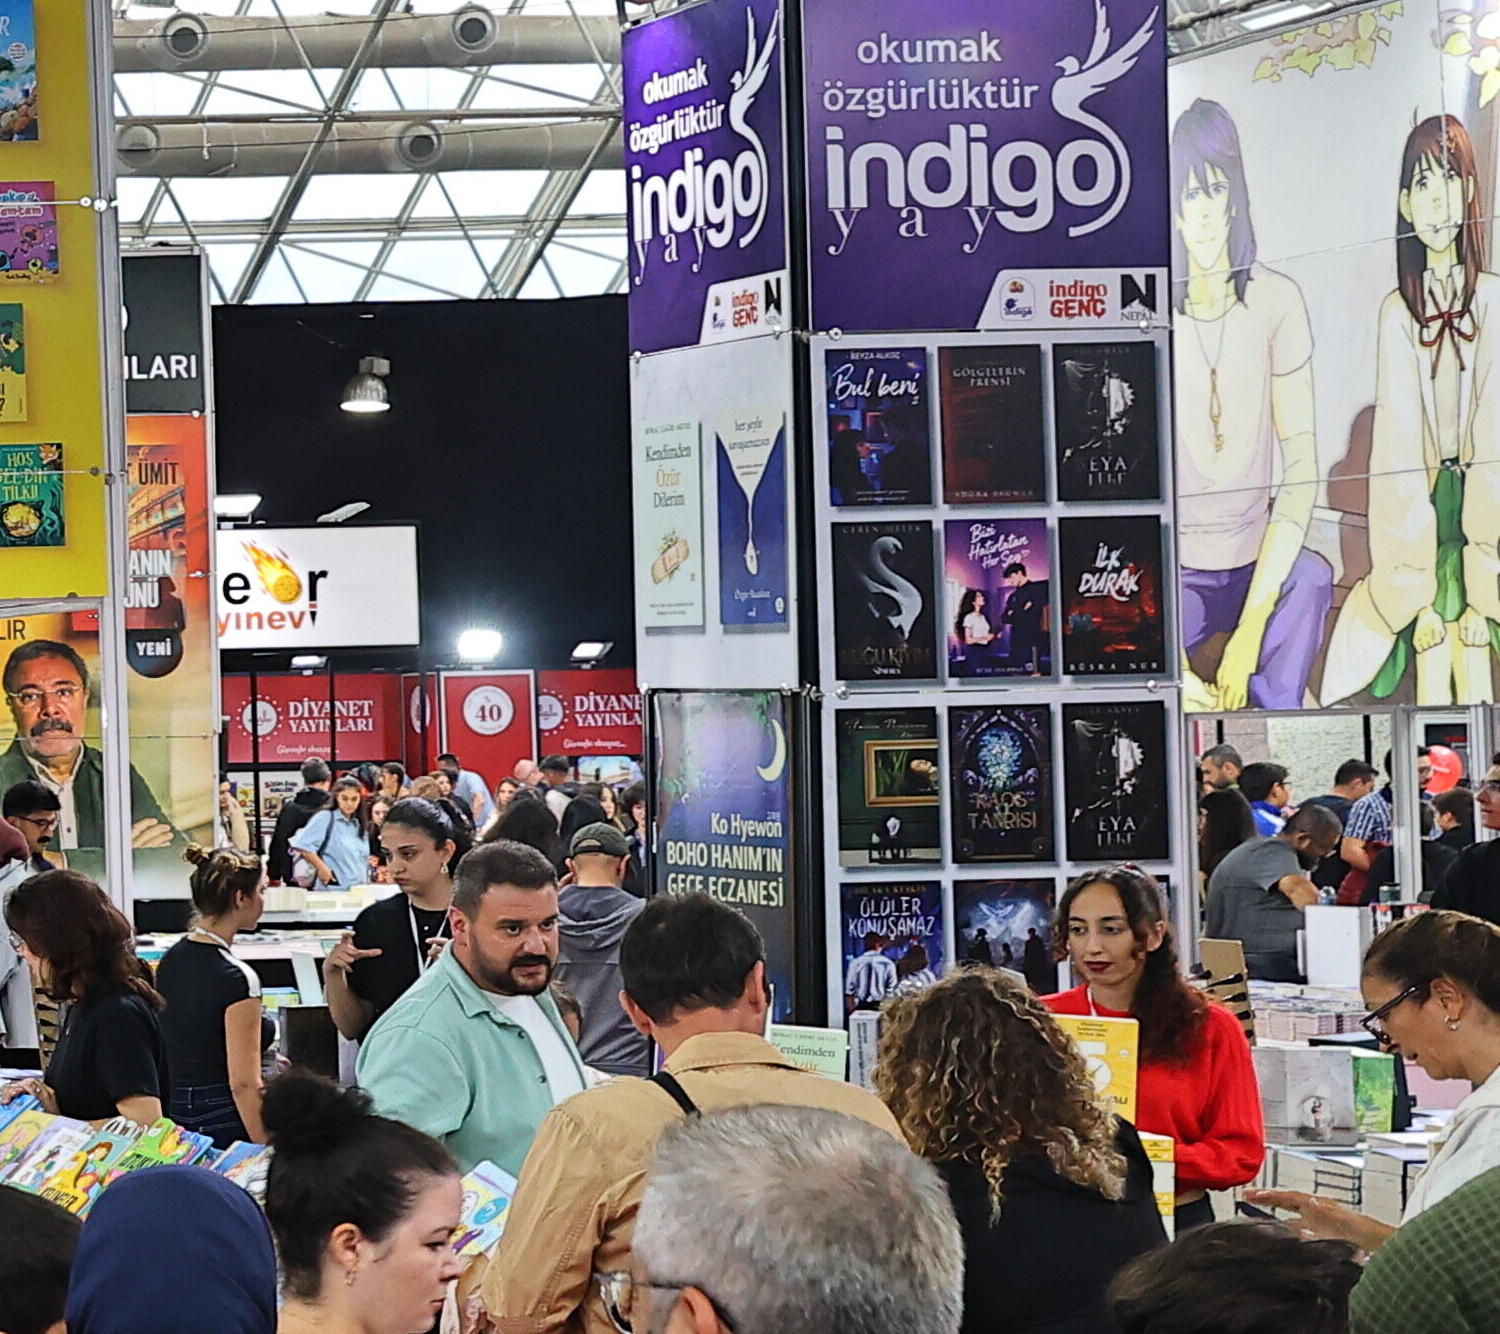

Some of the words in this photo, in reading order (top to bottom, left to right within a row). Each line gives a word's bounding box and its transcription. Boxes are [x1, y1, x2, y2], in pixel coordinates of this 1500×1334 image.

[858, 30, 1002, 65] okumak
[642, 58, 708, 105] okumak
[822, 77, 1040, 118] özgürlüktür
[629, 98, 724, 154] özgürlüktür
[826, 123, 1130, 237] indigo
[631, 147, 767, 248] indigo
[1048, 279, 1107, 301] indigo
[1049, 299, 1107, 320] GENÇ
[832, 363, 872, 401] Bul
[878, 366, 921, 397] beni
[644, 445, 692, 463] Kendimden
[139, 458, 180, 485] ÜMİT
[655, 464, 682, 489] Özür
[653, 489, 685, 508] Dilerim
[969, 523, 997, 544] Bizi
[1094, 542, 1125, 569] İLK
[1077, 568, 1144, 601] DURAK
[136, 638, 172, 657] YENİ
[288, 697, 374, 718] DİYANET
[474, 704, 501, 721] 40
[574, 711, 643, 727] YAYINLA
[288, 717, 374, 733] YAYINLARI
[711, 813, 729, 834] Ko
[731, 816, 782, 843] Hyewon
[967, 811, 1037, 829] TANRISI
[666, 841, 710, 867] BOHO
[668, 872, 704, 897] GECE
[708, 875, 784, 907] ECZANESİ
[859, 896, 922, 917] ÖLÜLER
[848, 915, 936, 941] KONUŞAMAZ
